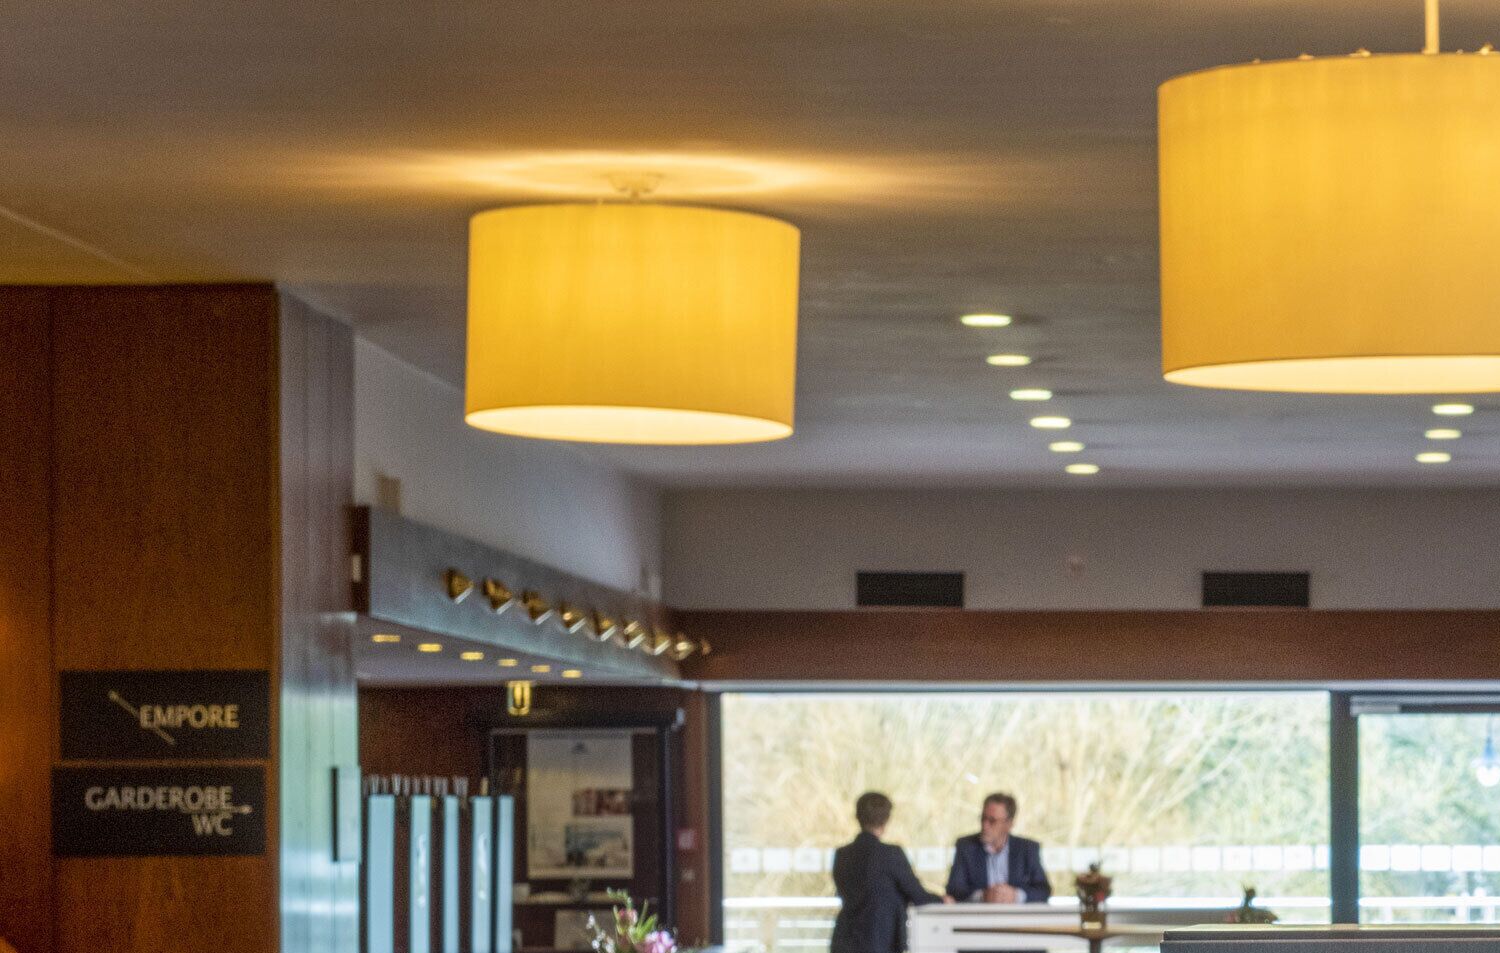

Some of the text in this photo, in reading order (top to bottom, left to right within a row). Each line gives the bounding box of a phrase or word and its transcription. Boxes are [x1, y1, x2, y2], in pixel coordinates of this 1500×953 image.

[139, 704, 240, 729] EMPORE
[85, 786, 233, 810] GARDEROBE
[191, 812, 234, 837] WC
